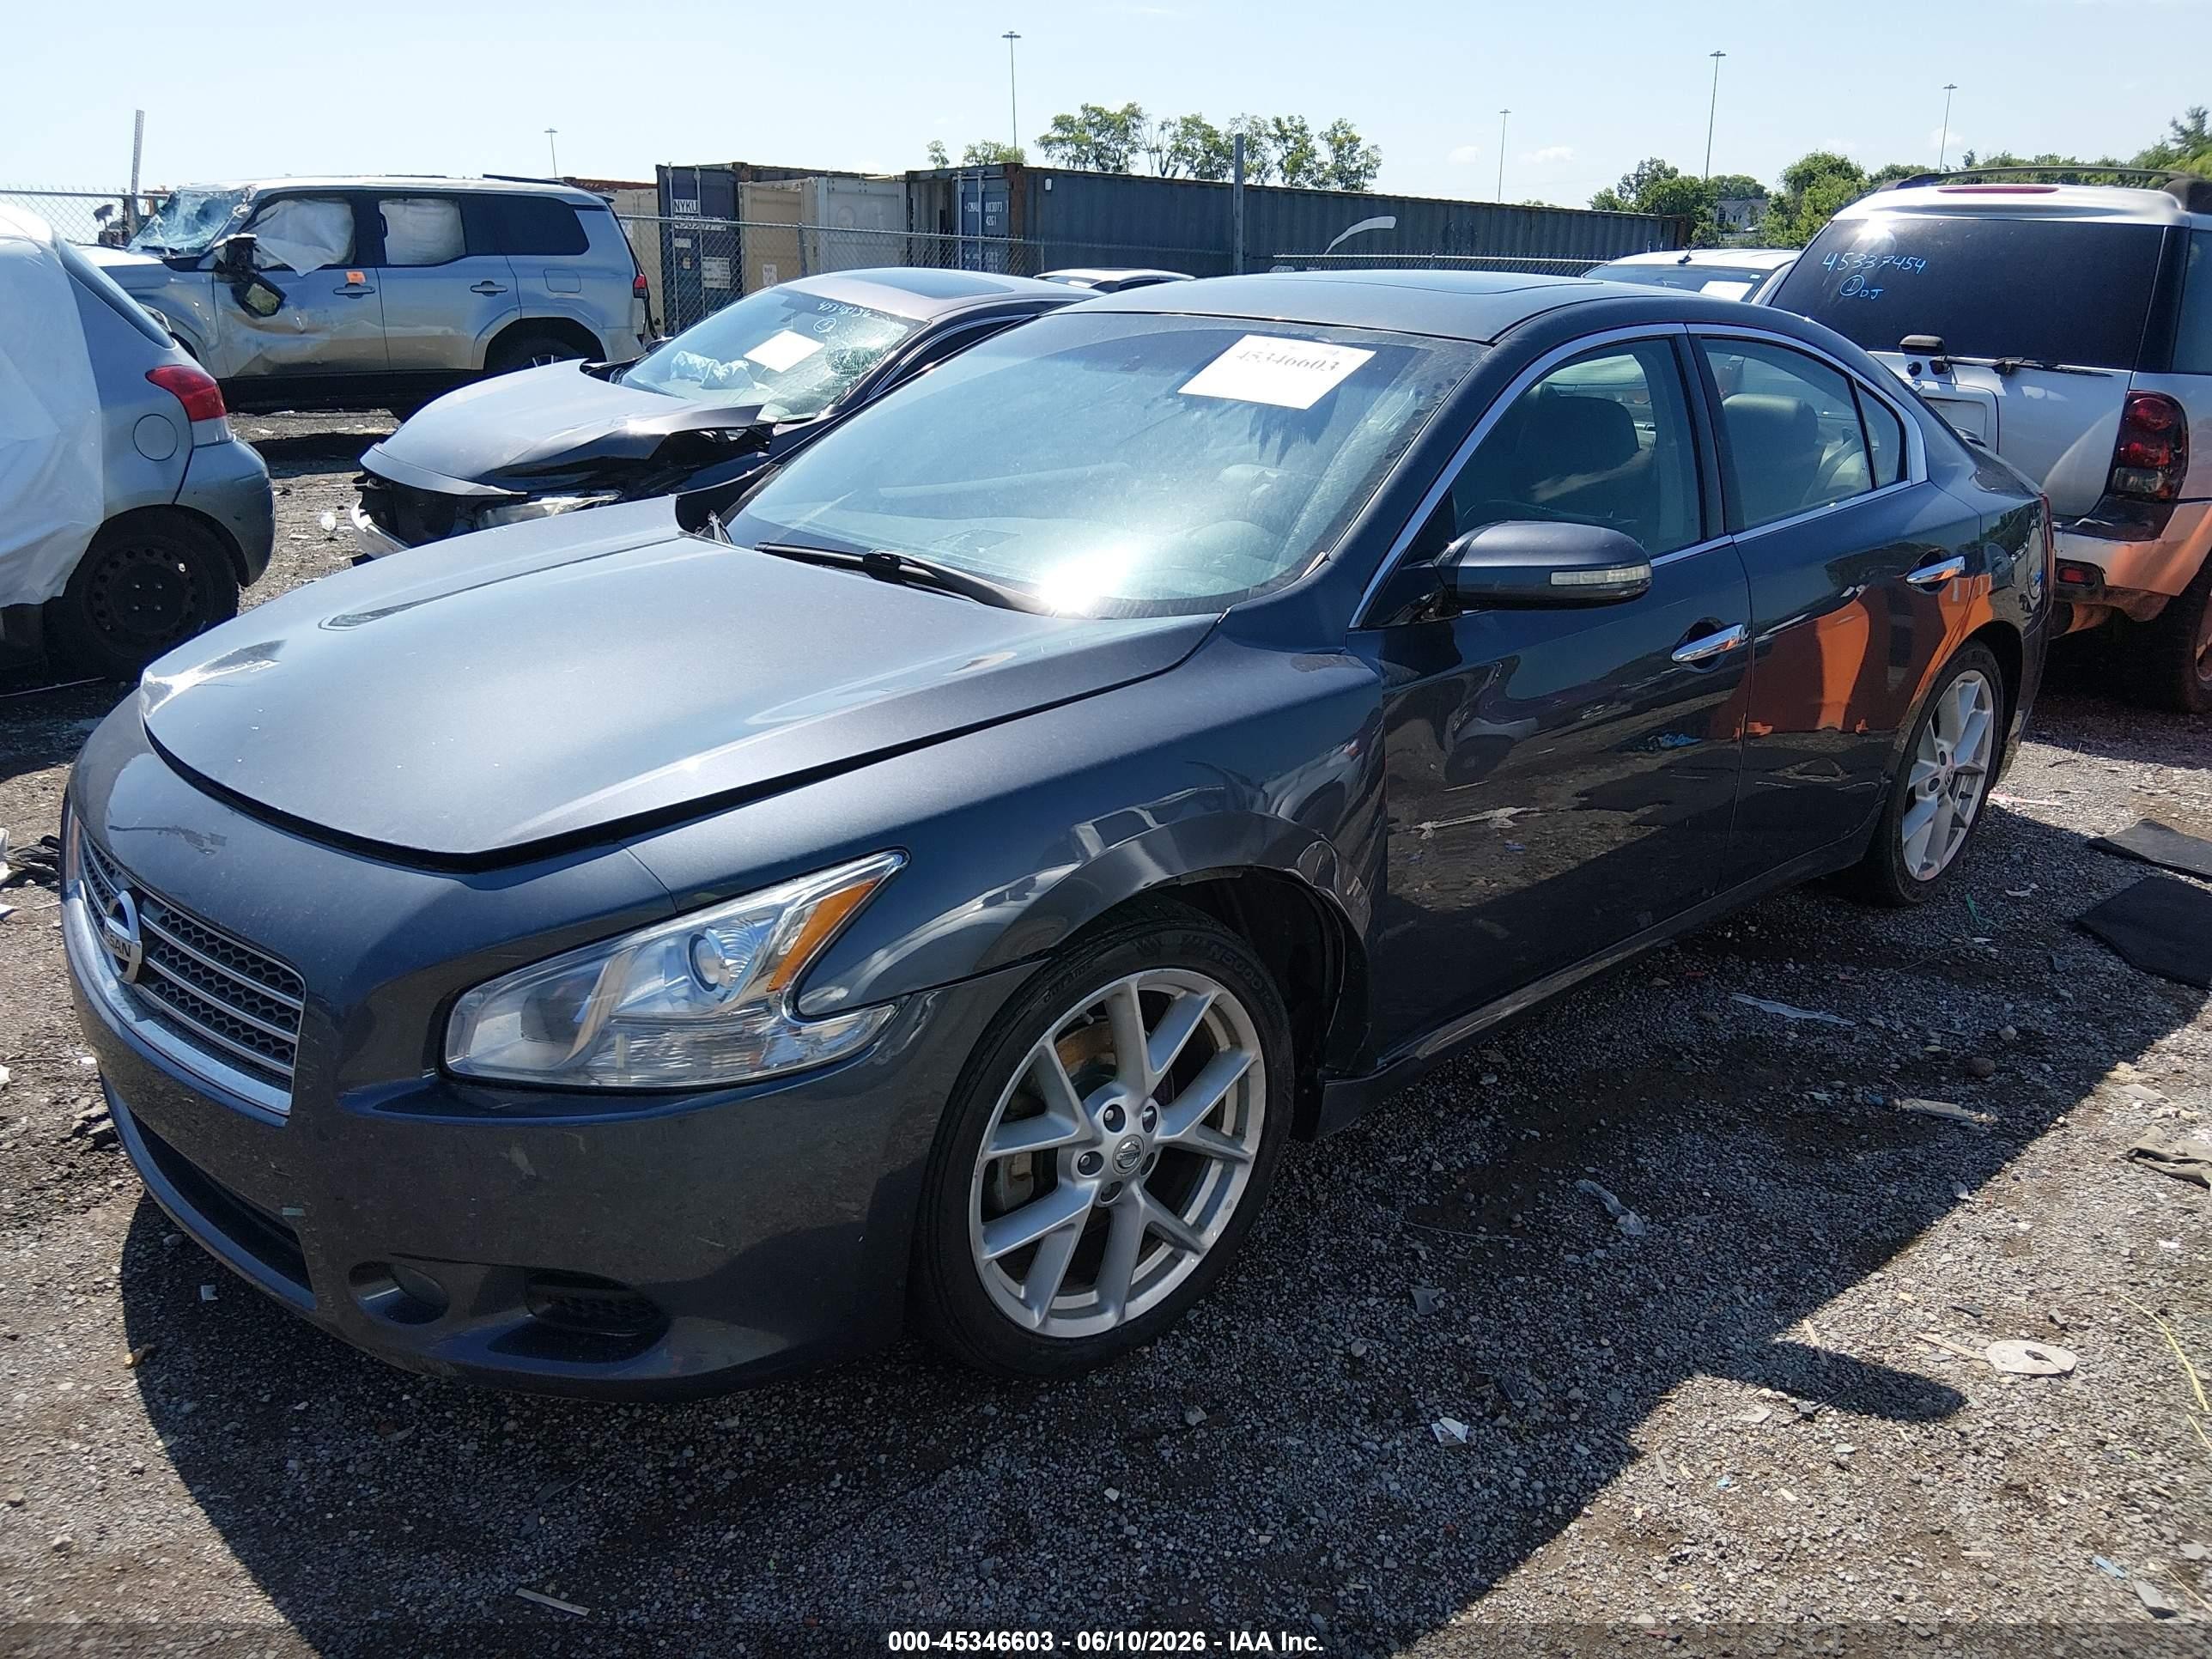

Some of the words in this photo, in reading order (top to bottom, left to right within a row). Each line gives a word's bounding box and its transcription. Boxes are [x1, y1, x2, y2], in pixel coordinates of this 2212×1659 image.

[673, 199, 698, 213] NYKU
[1821, 252, 1927, 275] 45337454
[1860, 289, 1884, 300] DJ
[1236, 350, 1340, 371] 45346603
